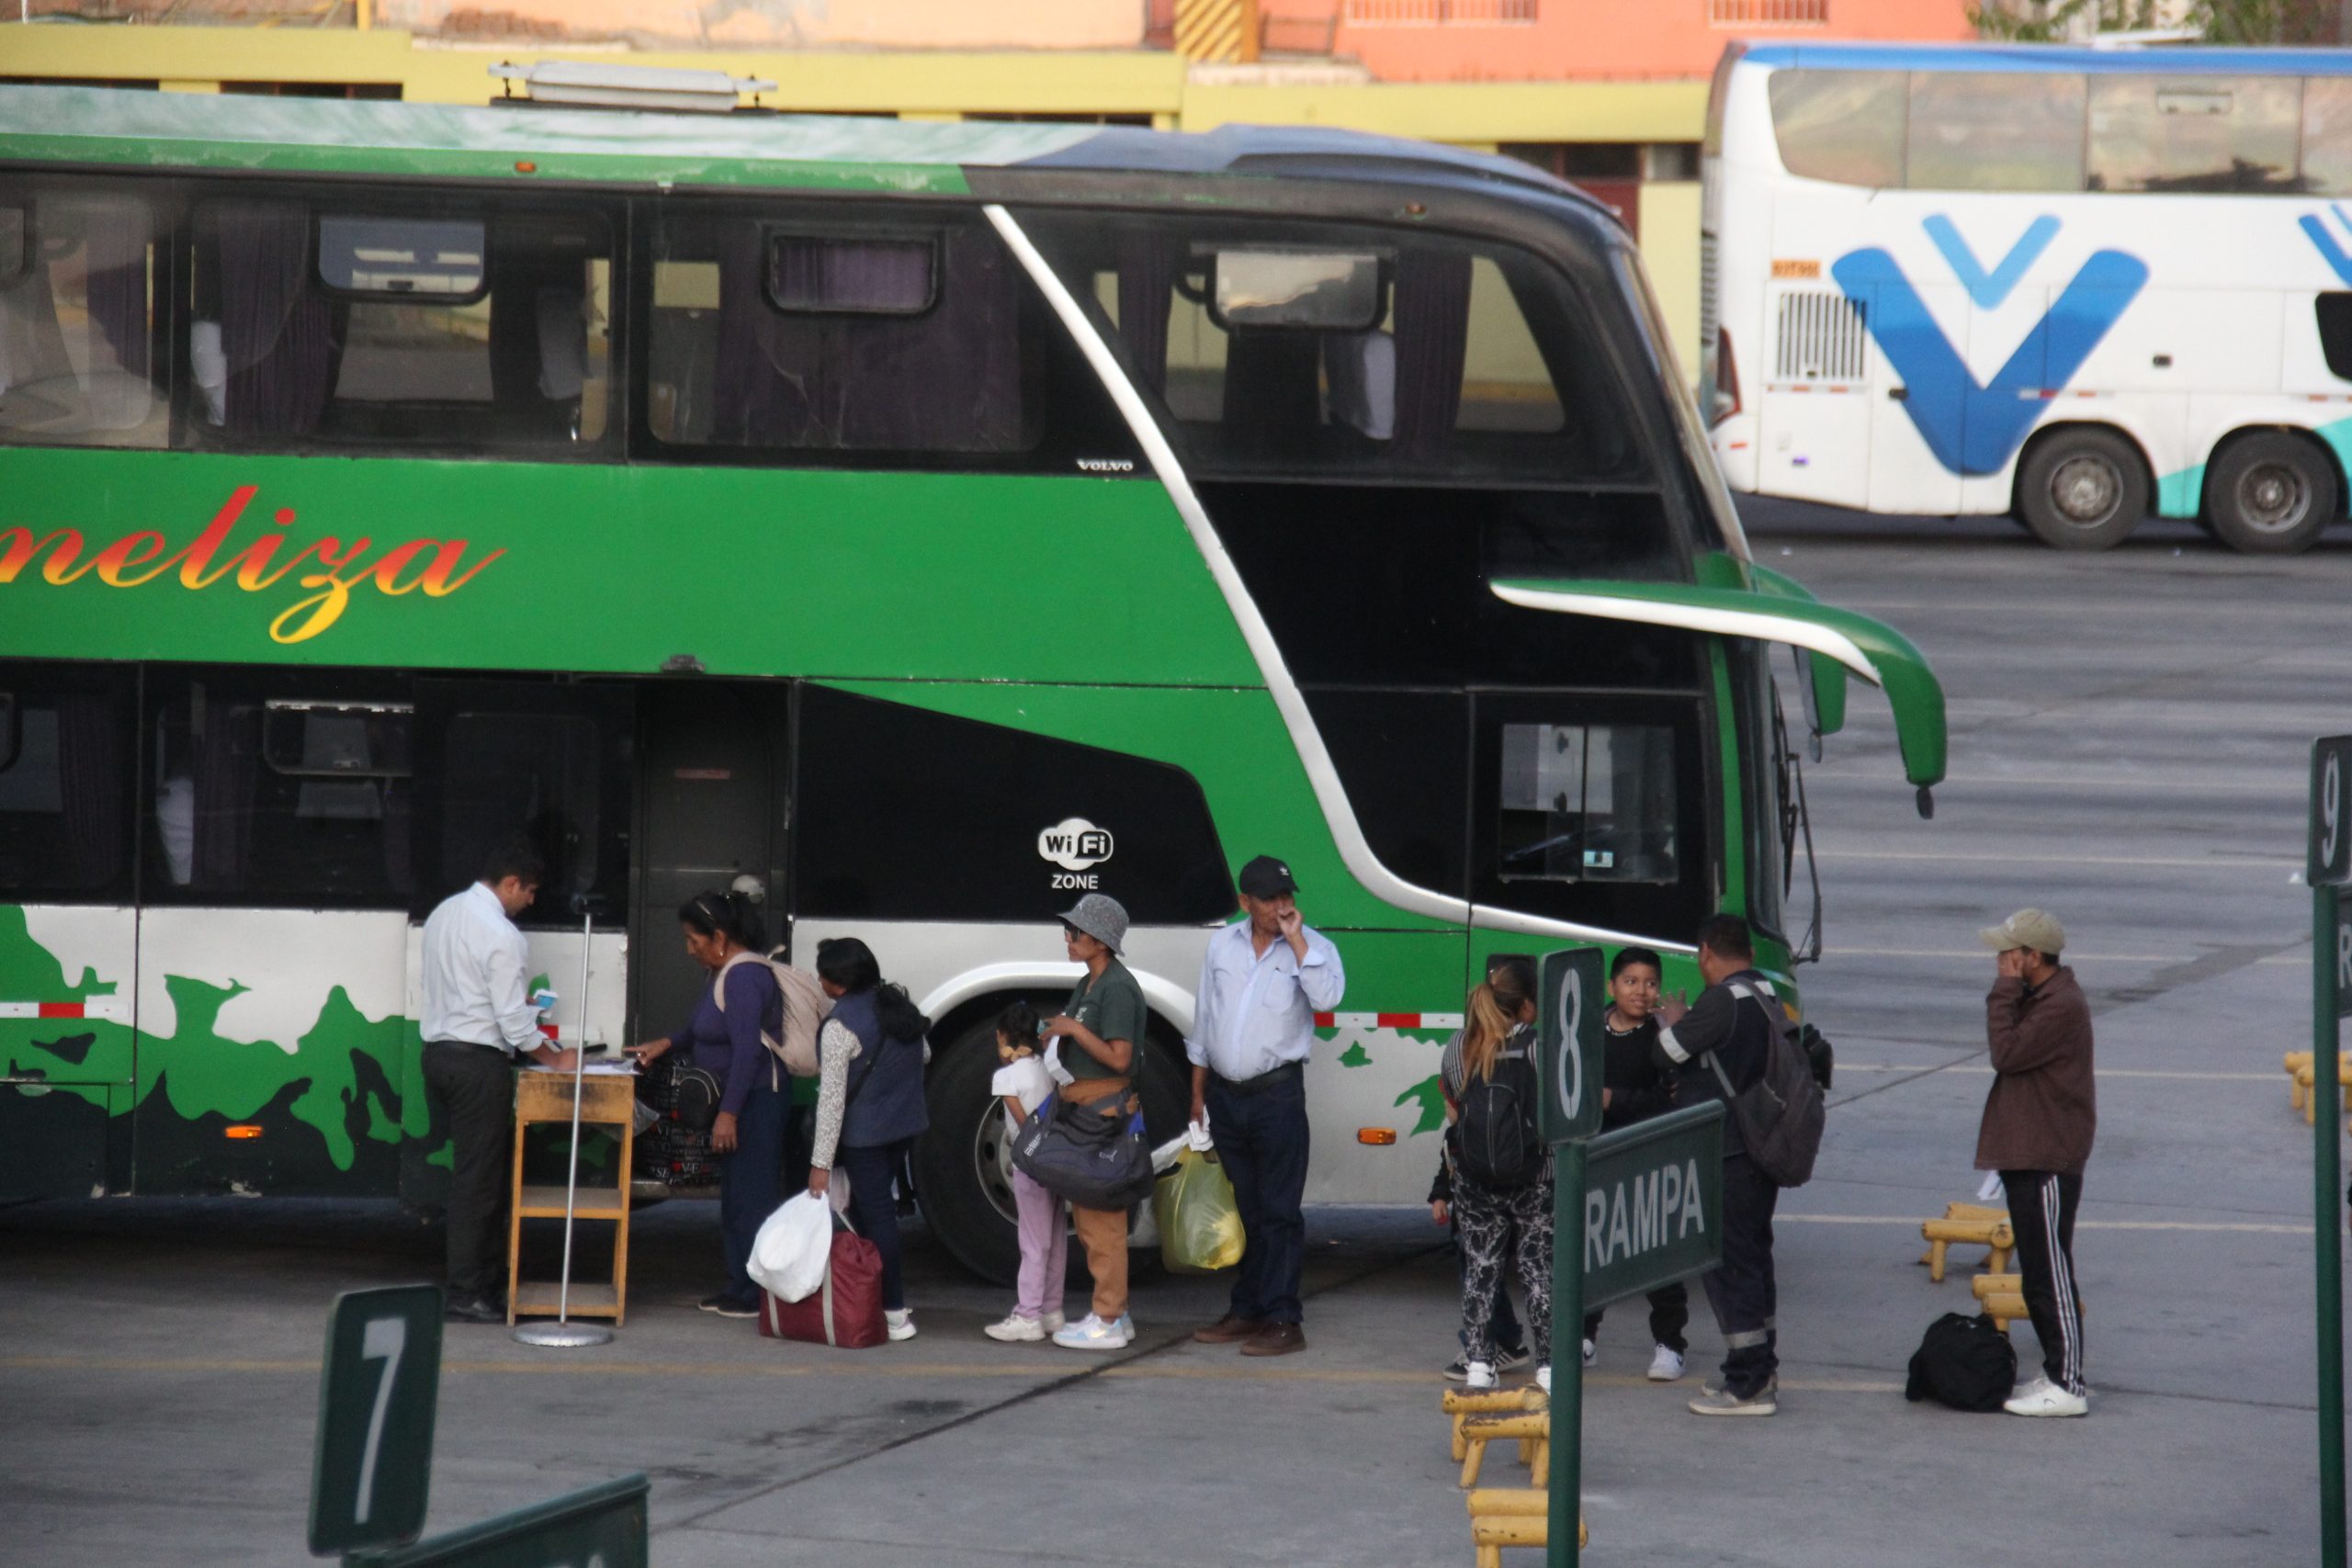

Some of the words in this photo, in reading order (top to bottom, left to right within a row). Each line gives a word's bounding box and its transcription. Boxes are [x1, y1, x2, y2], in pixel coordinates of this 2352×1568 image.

[1076, 458, 1134, 471] VOLVO
[2322, 750, 2340, 870] 9
[1051, 874, 1099, 890] ZONE
[1558, 967, 1582, 1121] 8
[1584, 1158, 1705, 1273] RAMPA
[355, 1316, 406, 1525] 7
